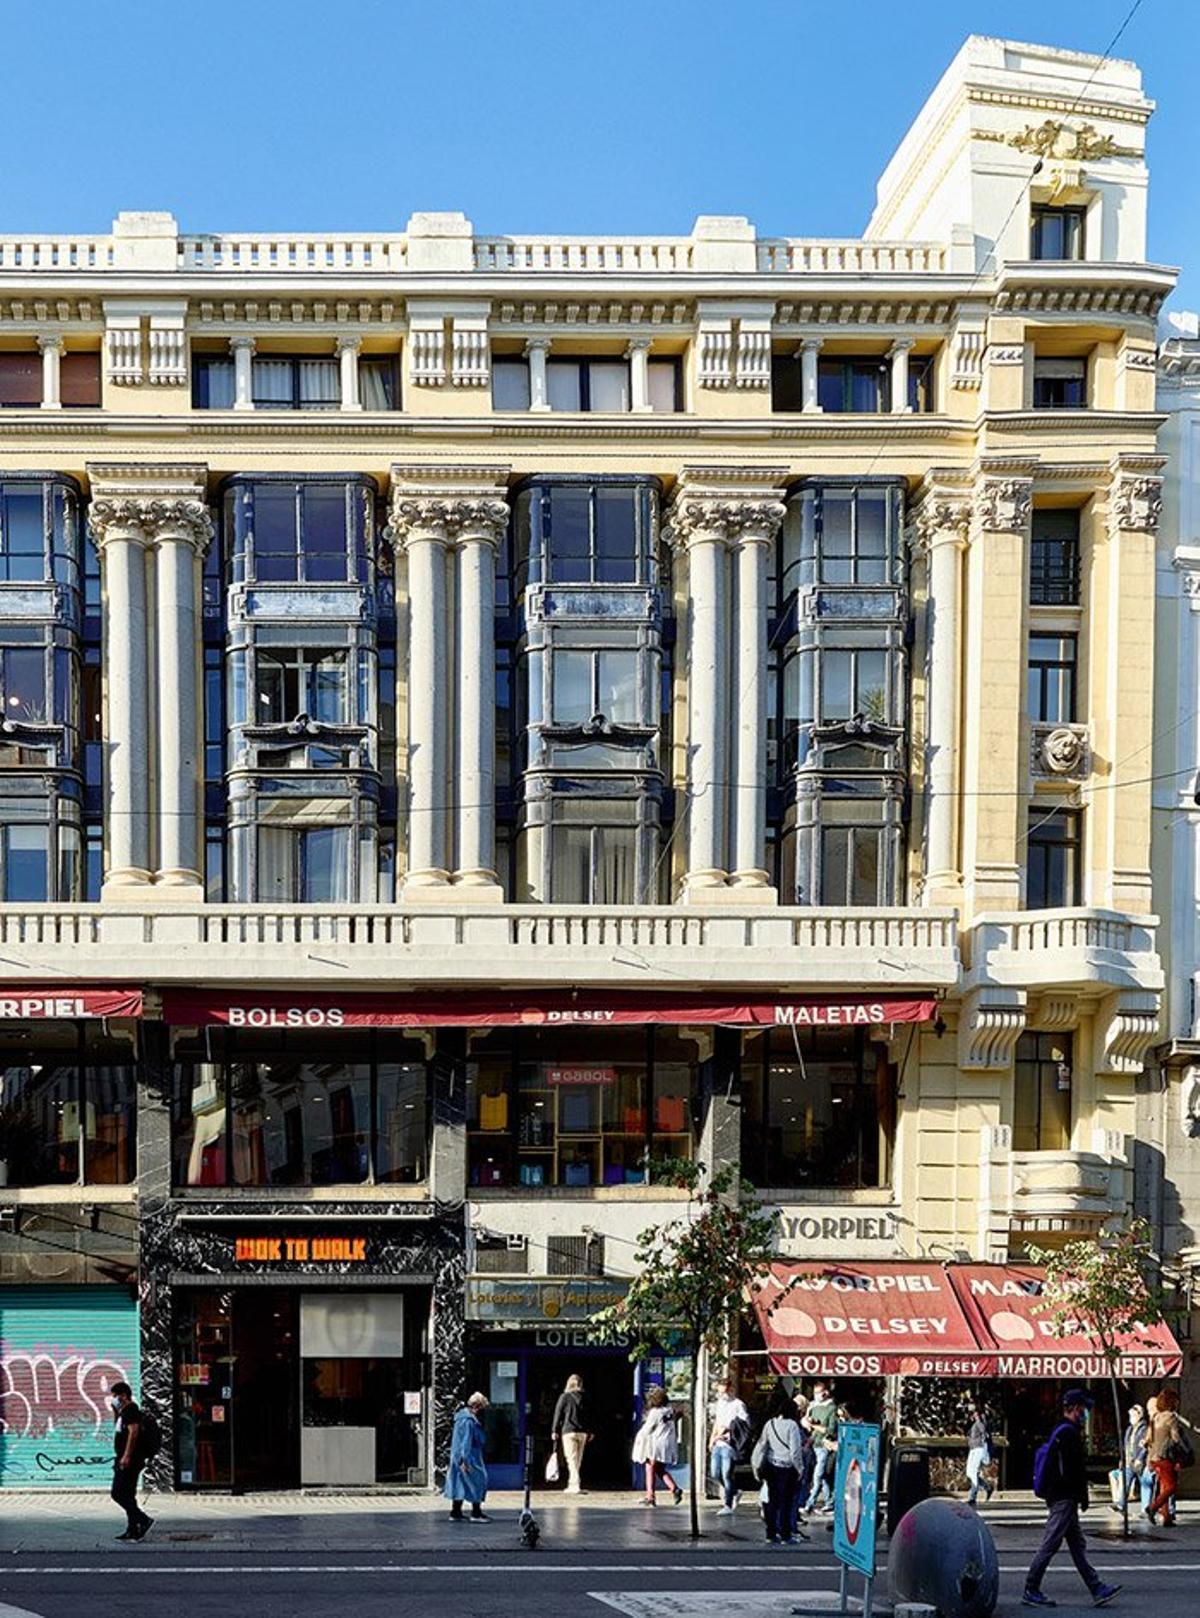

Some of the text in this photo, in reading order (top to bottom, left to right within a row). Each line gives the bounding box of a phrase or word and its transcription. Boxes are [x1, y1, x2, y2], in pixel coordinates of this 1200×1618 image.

[229, 1007, 344, 1026] BOLSOS
[547, 1010, 615, 1021] DELSEY
[775, 1004, 885, 1025] MALETAS
[236, 1238, 366, 1260] WOK TO WALK
[822, 1317, 947, 1335] DELSEY
[788, 1355, 1168, 1376] BOLSOS DELSEY MARROQUINERIA
